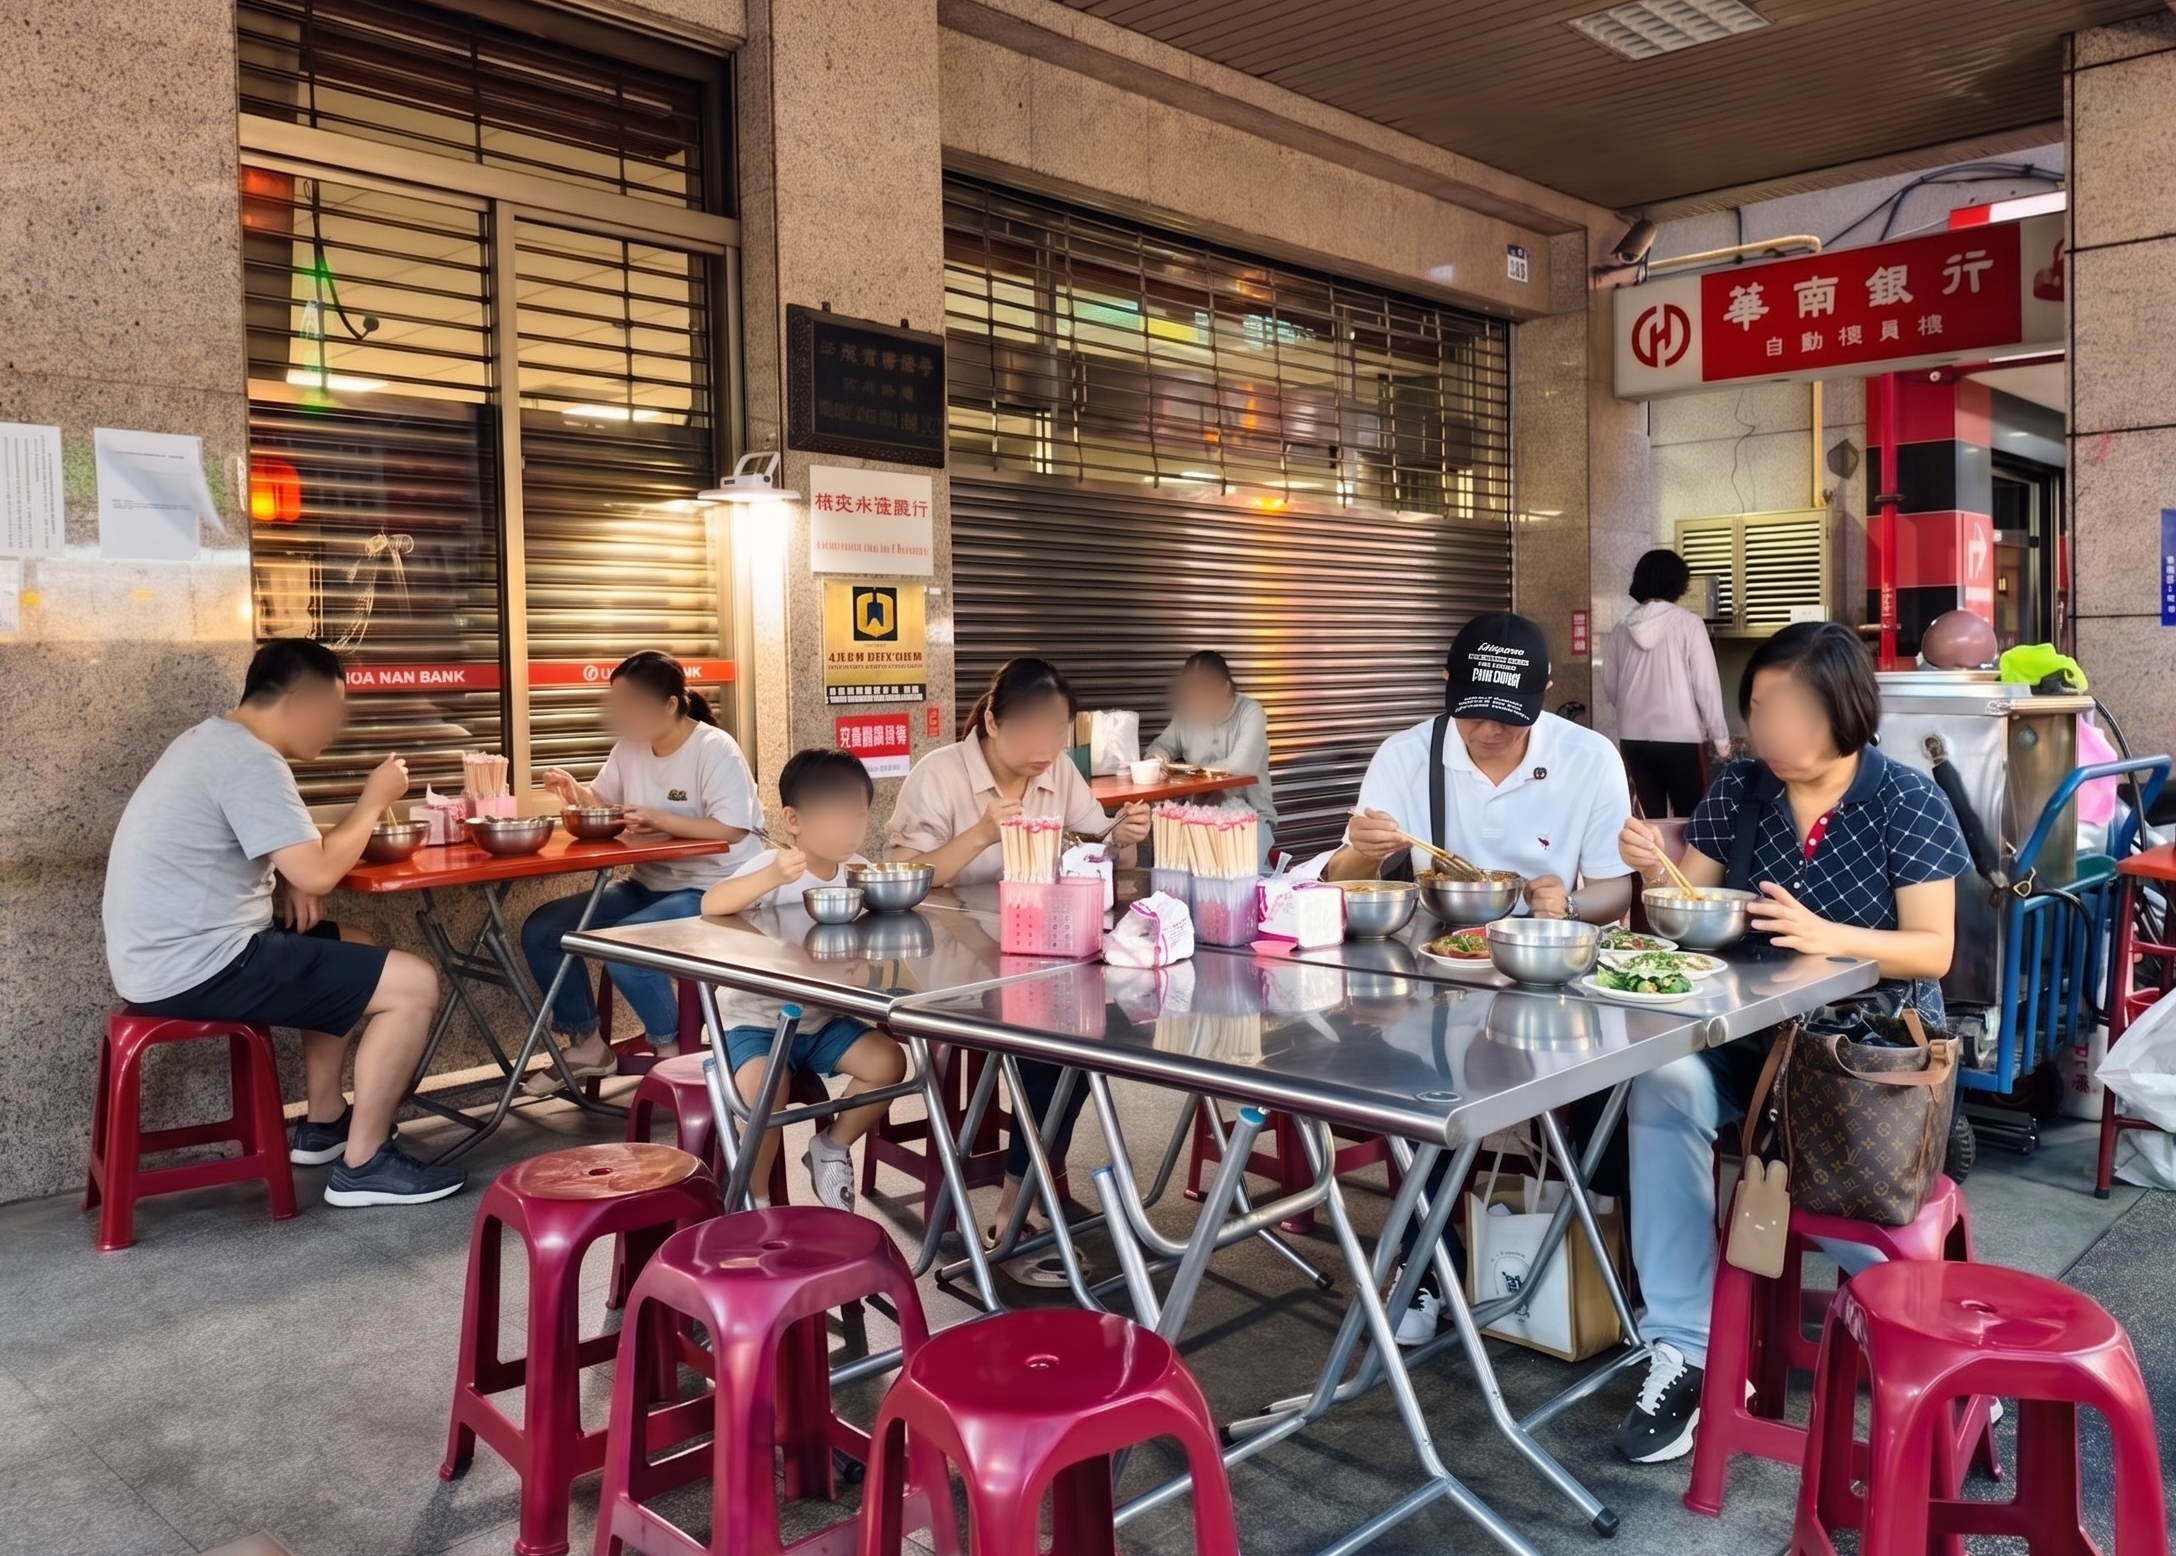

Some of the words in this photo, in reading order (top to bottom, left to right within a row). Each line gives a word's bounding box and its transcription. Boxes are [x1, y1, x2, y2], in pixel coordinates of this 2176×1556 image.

[1722, 248, 1995, 332] 華南銀行
[379, 671, 415, 684] NAN
[419, 670, 466, 683] BANK
